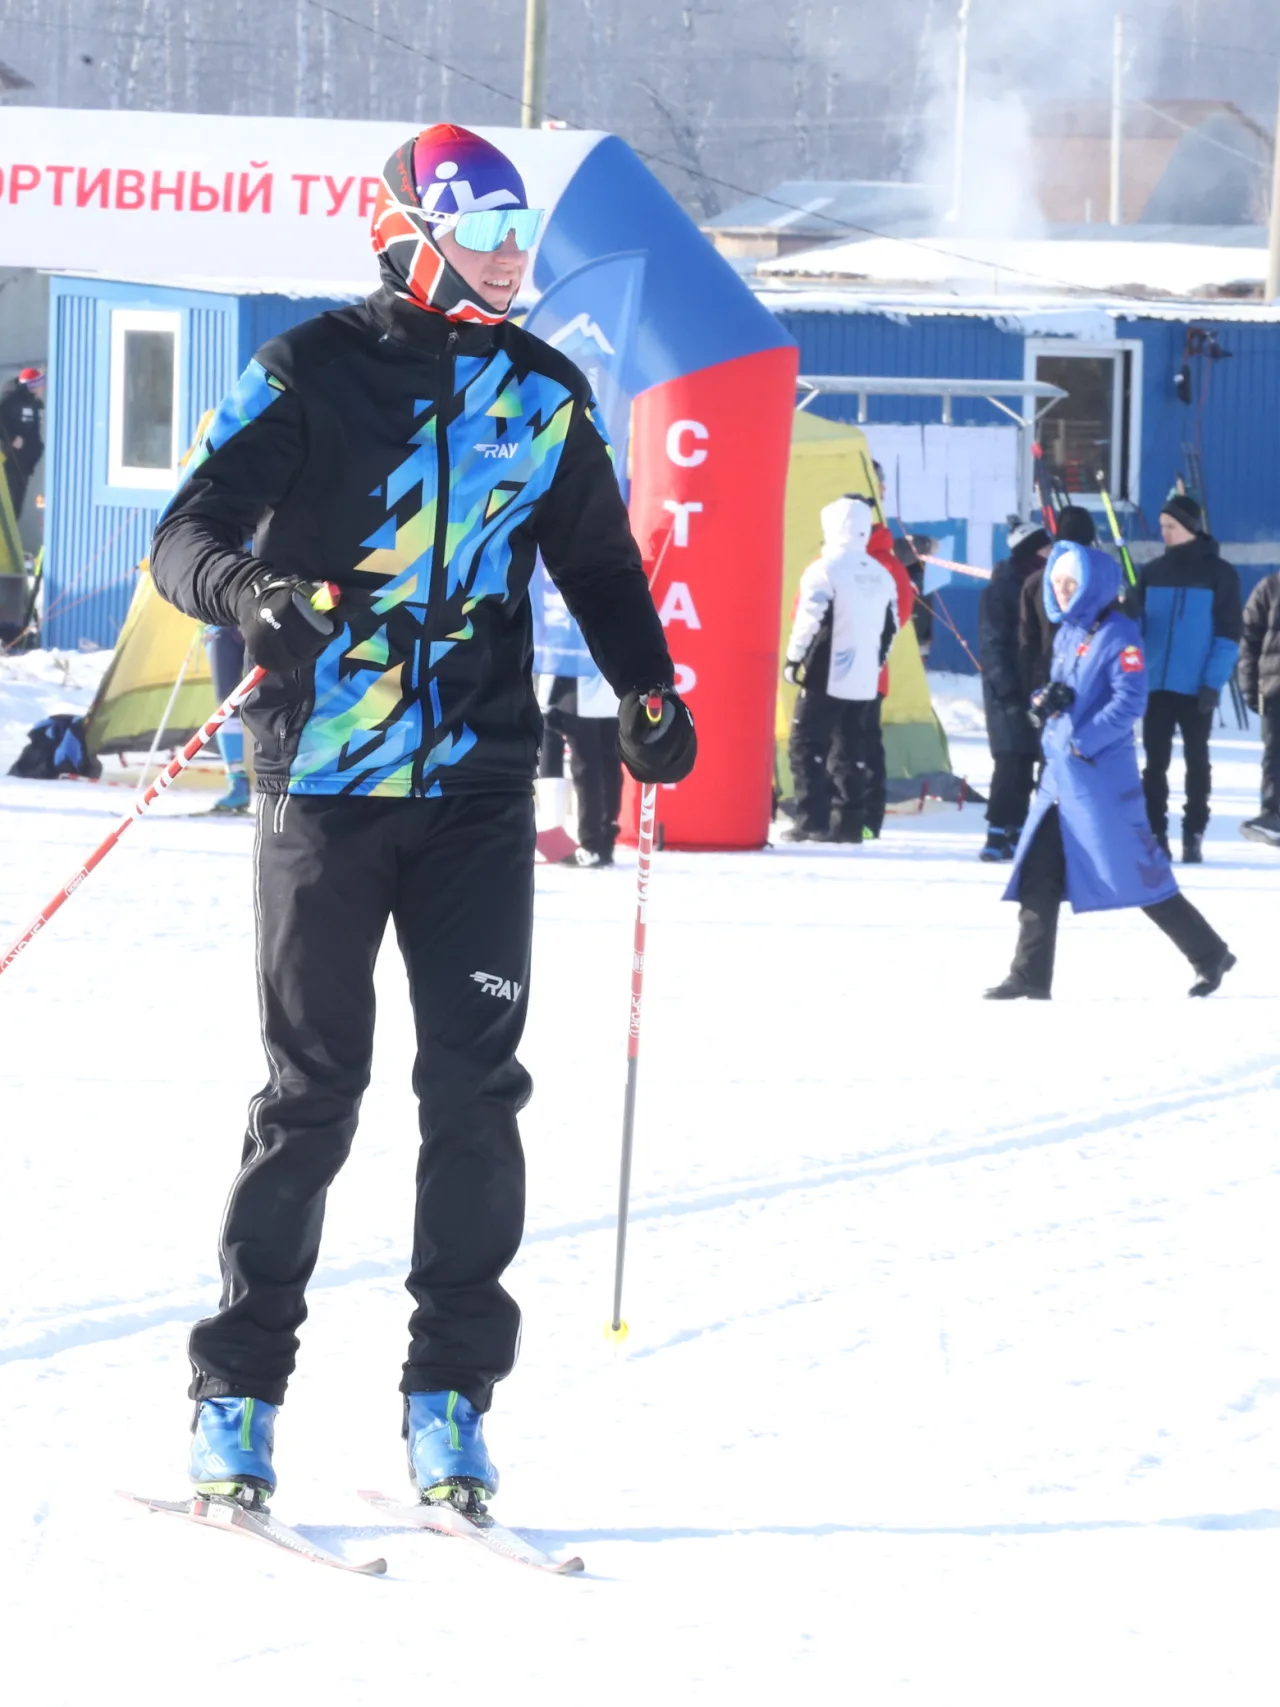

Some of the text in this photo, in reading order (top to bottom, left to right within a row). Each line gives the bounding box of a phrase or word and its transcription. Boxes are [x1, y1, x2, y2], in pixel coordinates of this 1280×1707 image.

[473, 443, 519, 459] RAY
[660, 420, 709, 790] СТАР
[469, 971, 522, 1002] RAY
